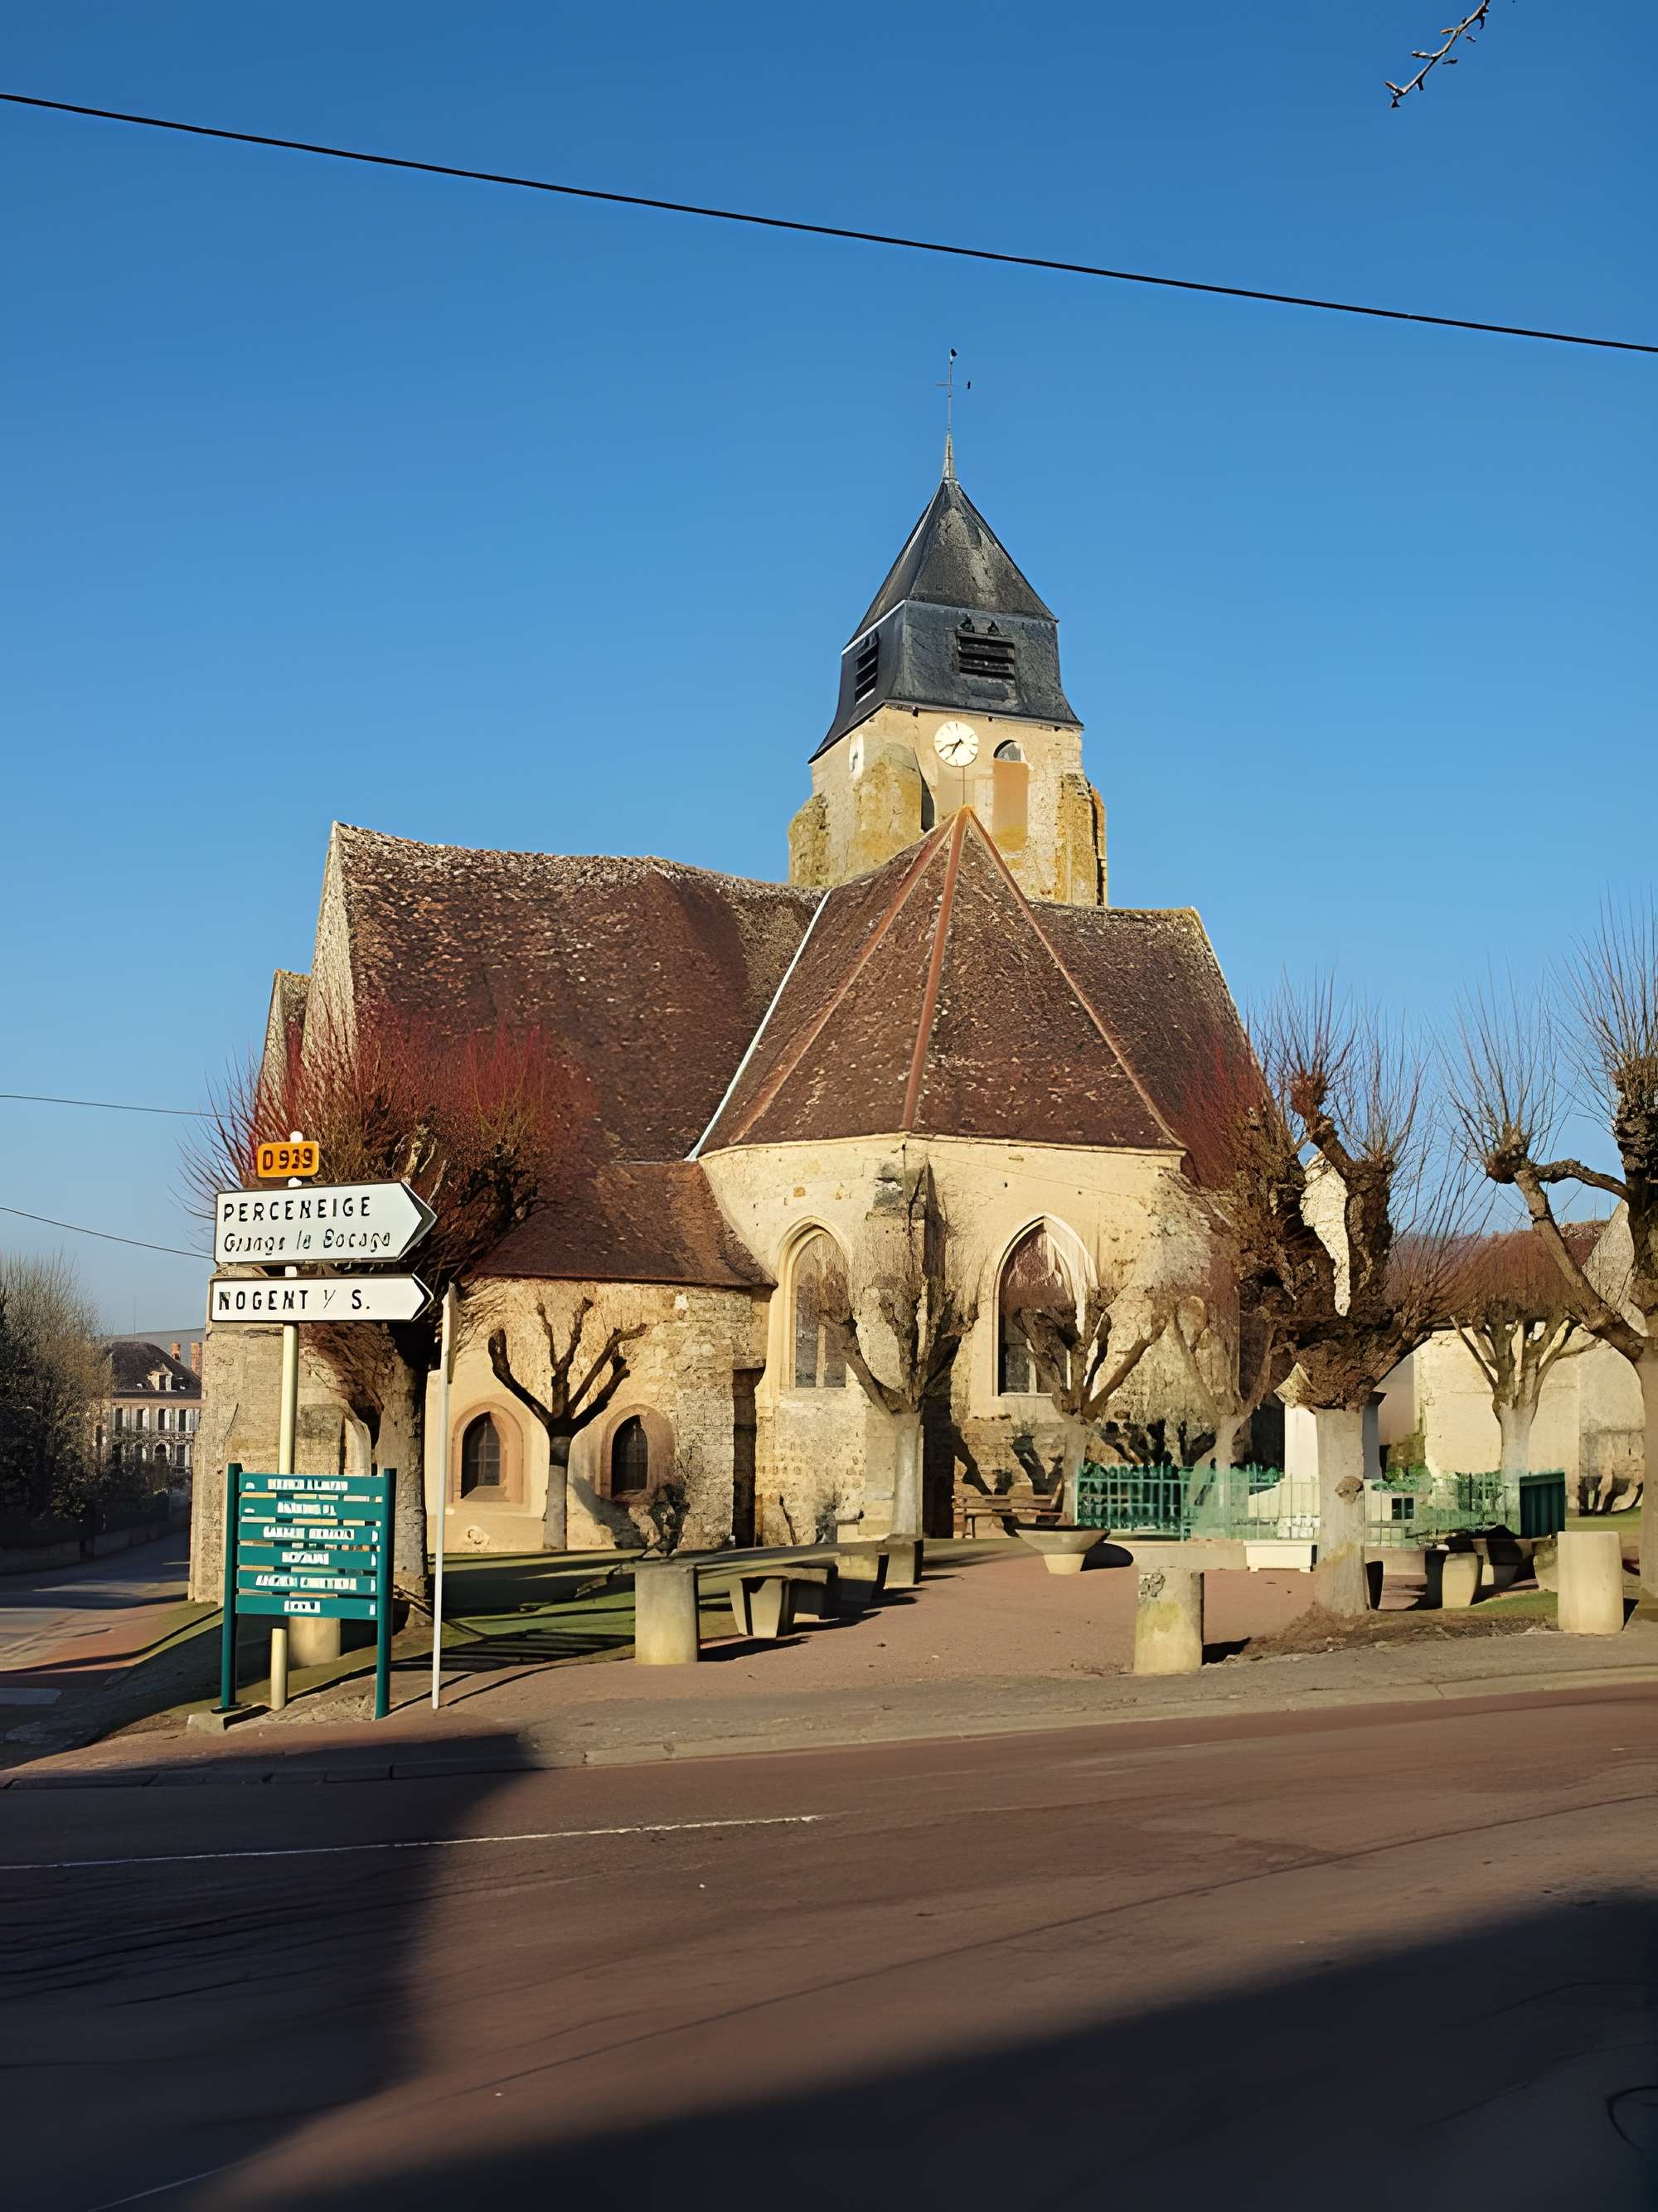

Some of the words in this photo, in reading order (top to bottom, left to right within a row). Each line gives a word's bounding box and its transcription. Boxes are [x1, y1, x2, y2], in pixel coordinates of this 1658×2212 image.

[223, 1196, 371, 1223] PERCENEIGE
[218, 1289, 309, 1311] NOGENT
[351, 1288, 371, 1310] S.
